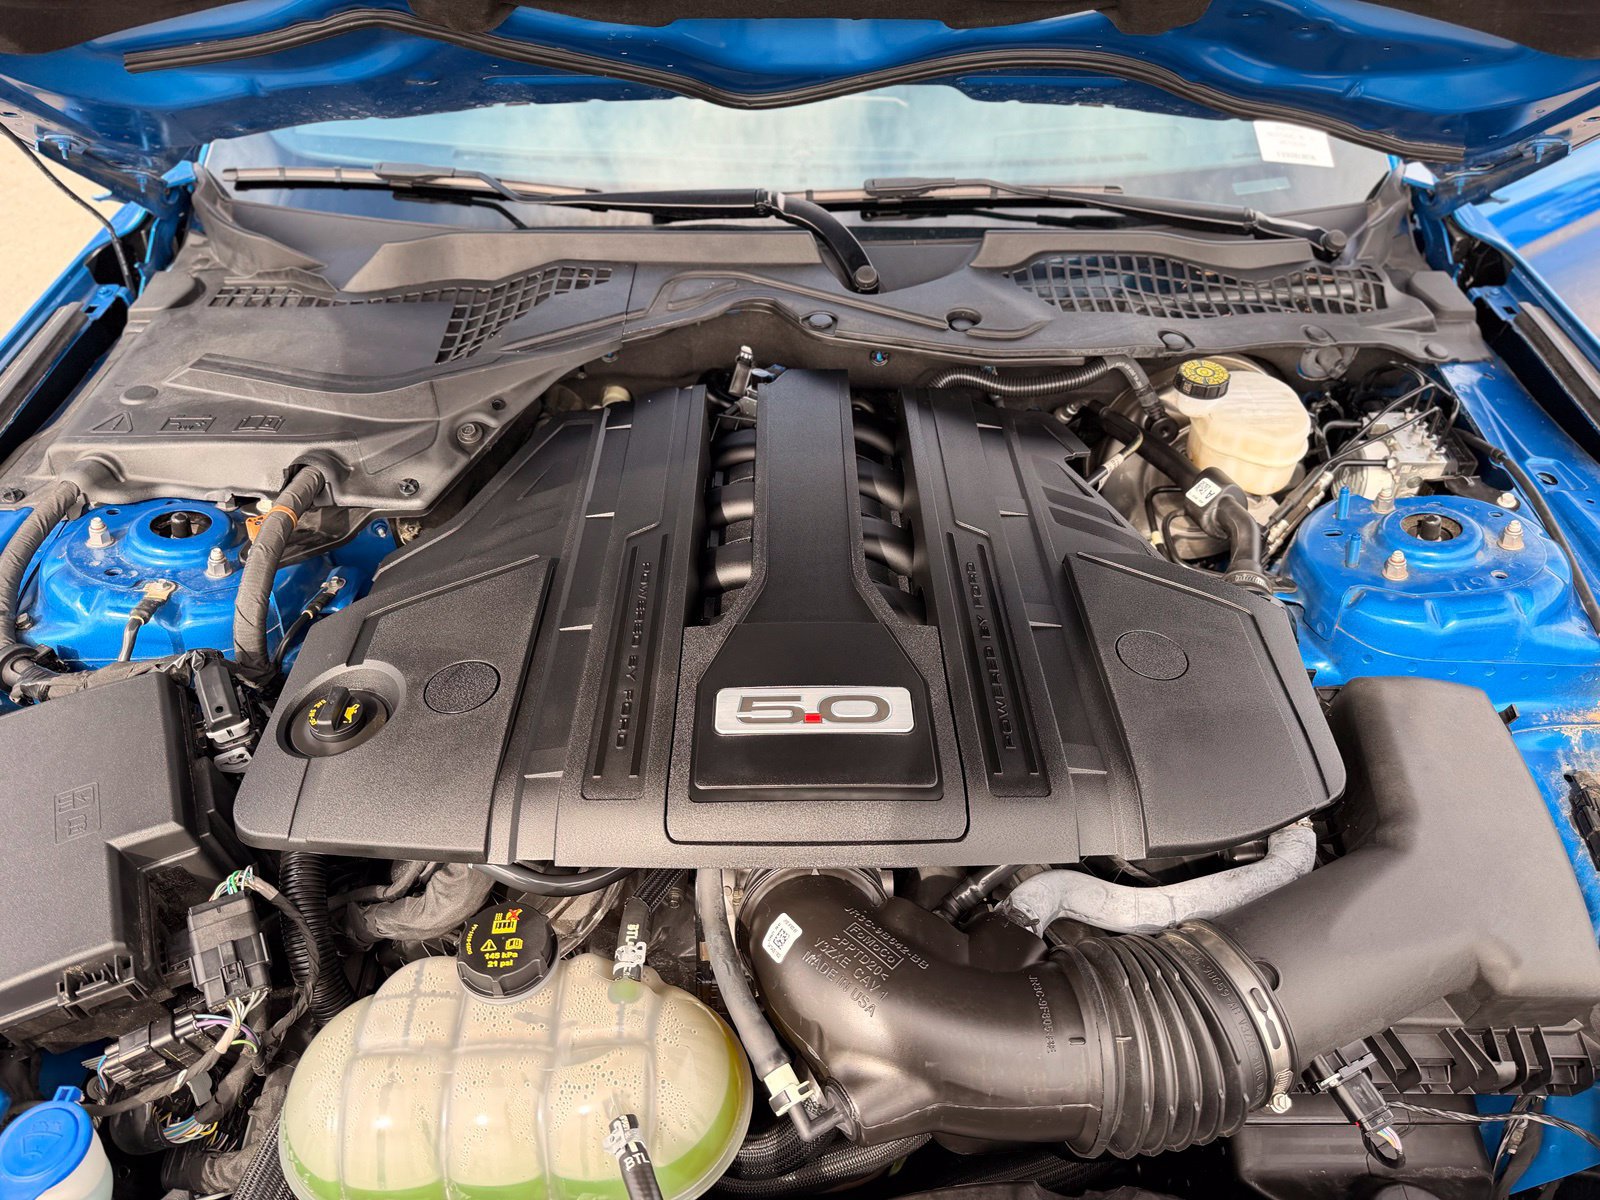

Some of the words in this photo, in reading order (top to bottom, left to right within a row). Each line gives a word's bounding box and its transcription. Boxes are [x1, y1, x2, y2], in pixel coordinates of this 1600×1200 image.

[965, 561, 985, 611] FORD
[632, 561, 653, 649] POWERED
[977, 614, 993, 640] BY
[626, 654, 640, 682] BY
[736, 694, 893, 724] 5.0
[983, 645, 1017, 750] POWERED
[615, 689, 634, 750] FORD
[501, 951, 519, 959] kPa
[849, 925, 896, 964] FoMoCo
[486, 960, 498, 968] 21
[499, 960, 514, 968] psi
[801, 950, 836, 984] MADE
[835, 974, 851, 995] IN
[848, 985, 877, 1018] USA
[852, 966, 881, 994] CAV
[623, 1152, 650, 1171] BTL
